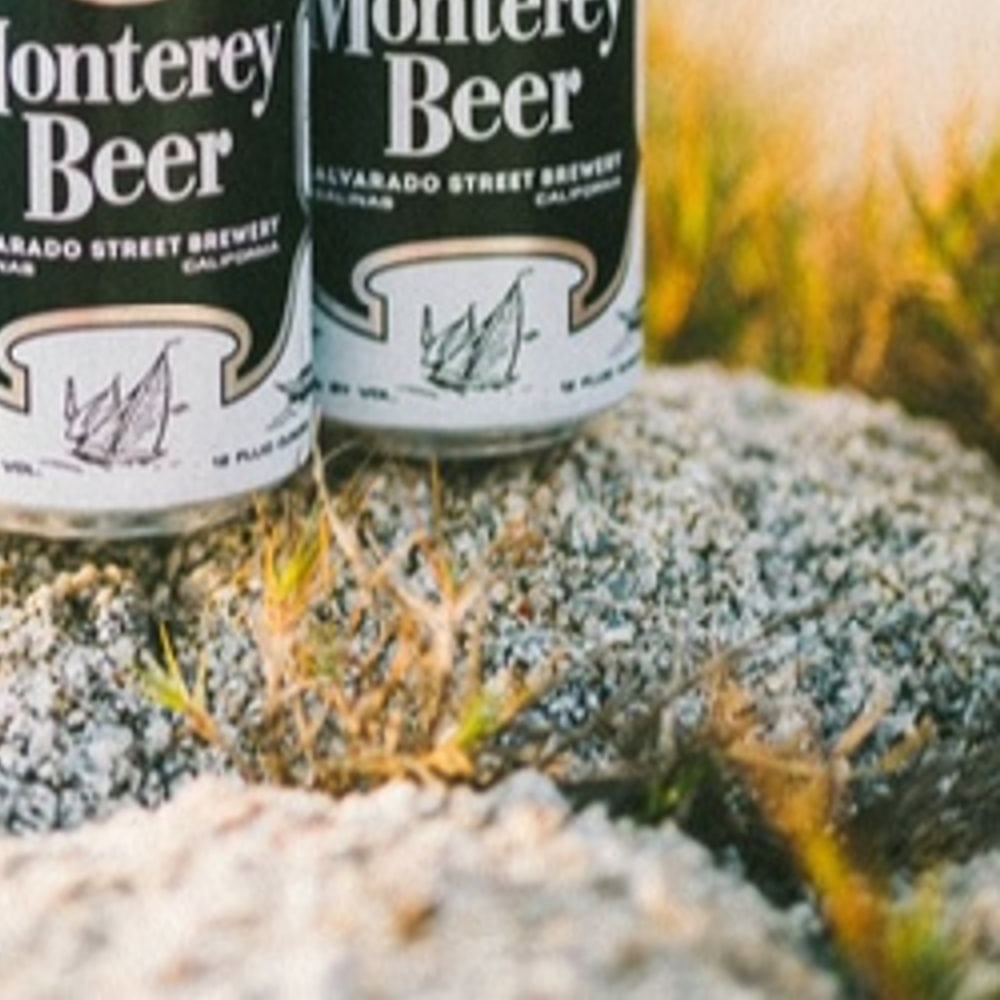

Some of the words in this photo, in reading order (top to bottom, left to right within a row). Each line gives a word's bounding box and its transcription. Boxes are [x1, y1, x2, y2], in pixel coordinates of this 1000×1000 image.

[384, 52, 583, 157] Beer
[23, 111, 233, 223] Beer
[315, 165, 441, 195] ALVARADO
[448, 169, 535, 195] STREET
[540, 150, 622, 188] BREWERY
[90, 232, 181, 261] STREET
[187, 213, 280, 253] BREWERY
